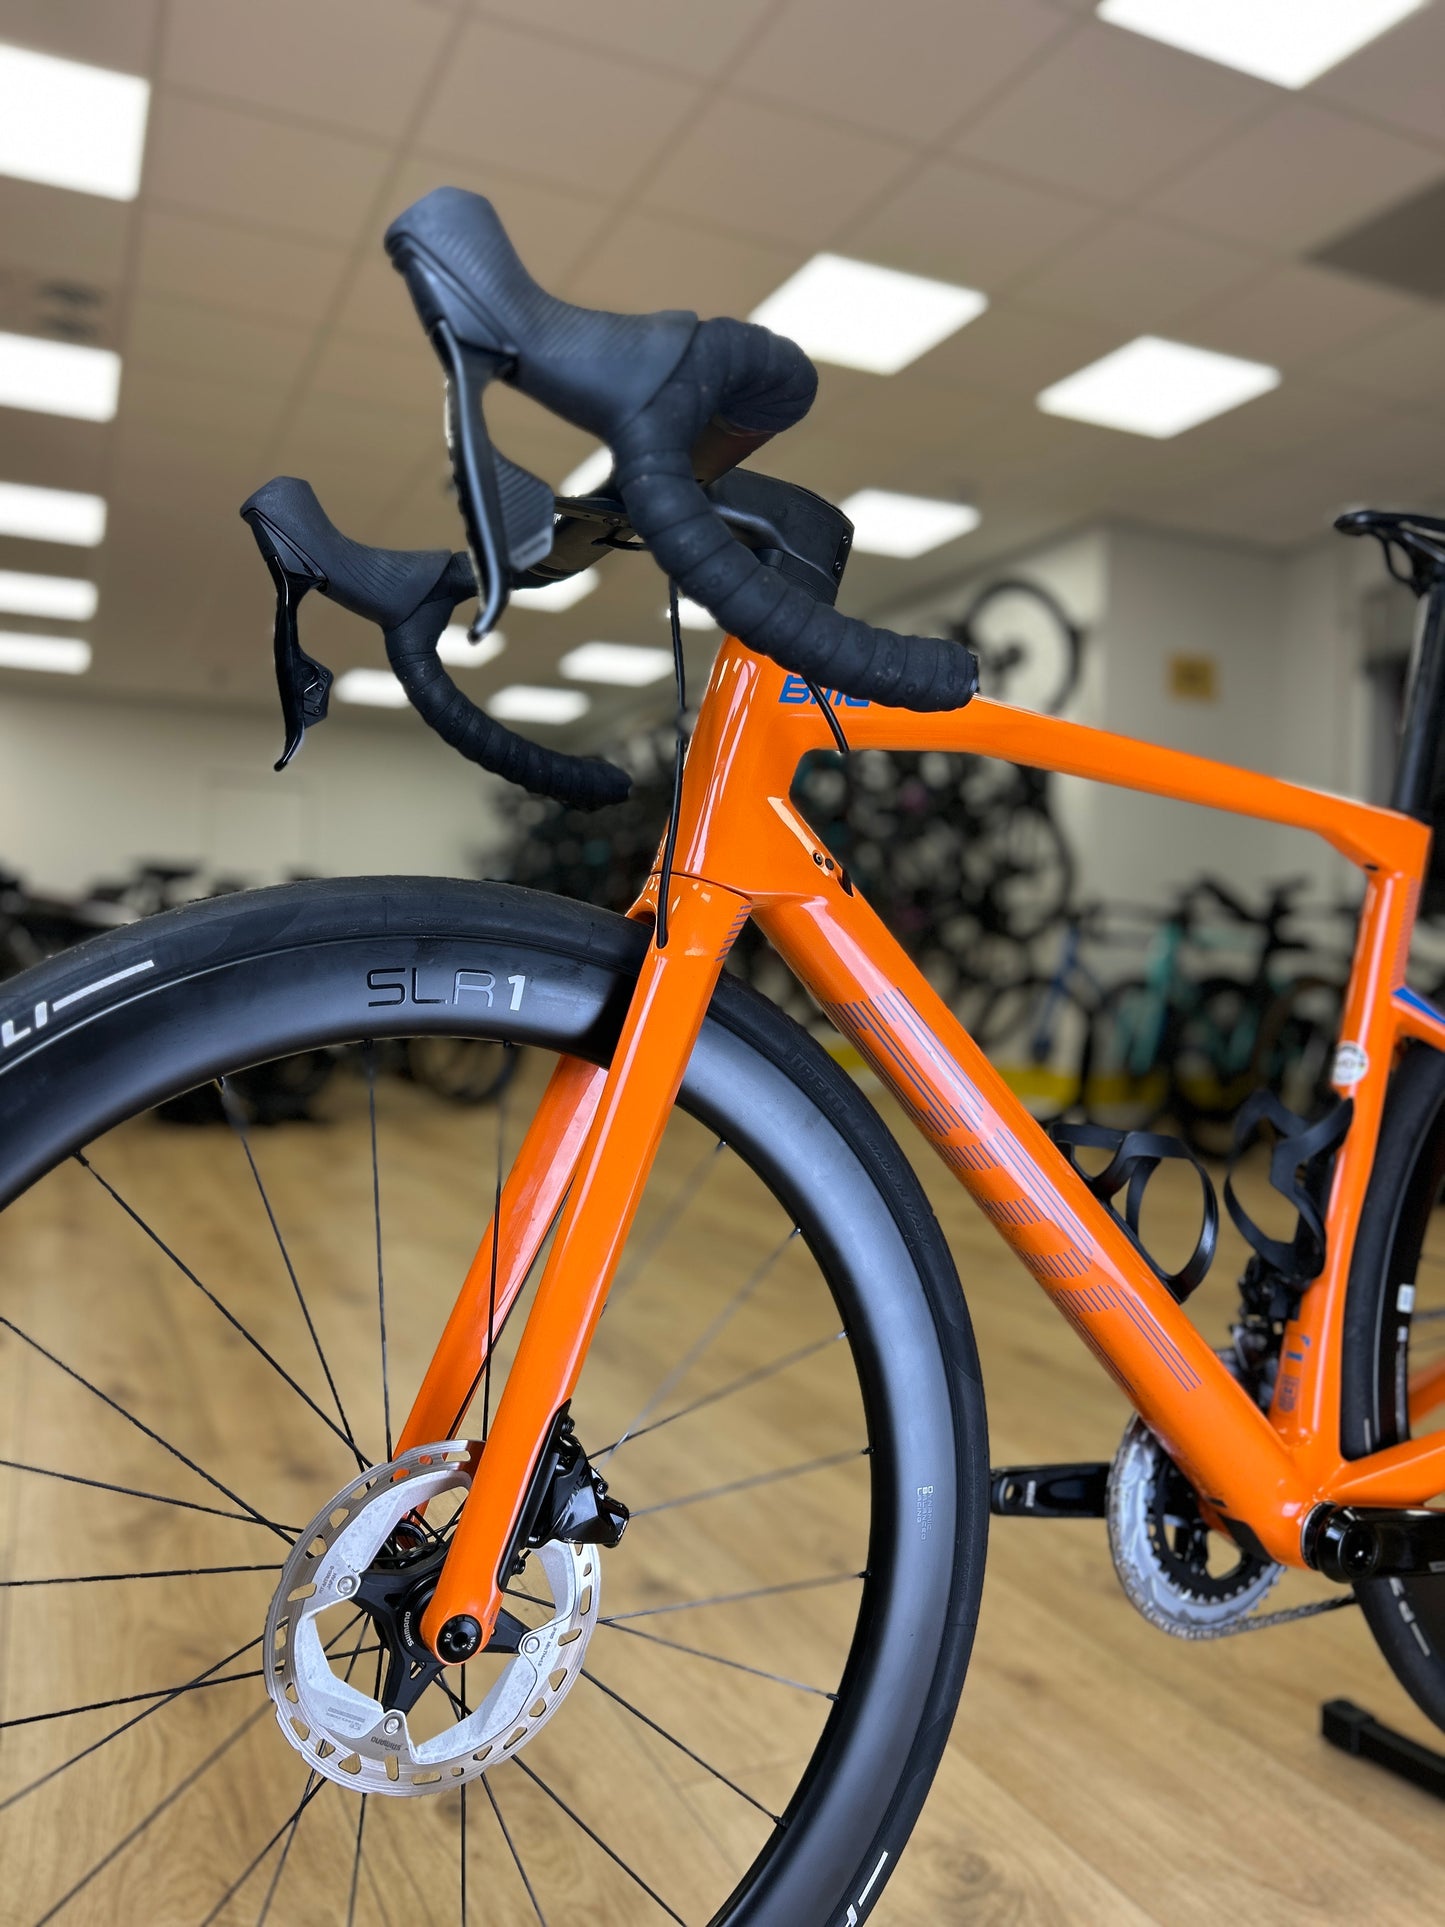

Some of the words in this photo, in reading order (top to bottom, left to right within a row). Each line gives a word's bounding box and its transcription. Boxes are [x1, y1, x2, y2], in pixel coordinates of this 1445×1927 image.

[784, 1046, 848, 1116] PIRELLI
[866, 1138, 896, 1180] MADE
[892, 1181, 908, 1200] IN
[903, 1201, 933, 1250] ITALY
[404, 1611, 414, 1647] SHIMANO
[444, 1633, 452, 1642] 10
[370, 1736, 401, 1750] SHIMANO
